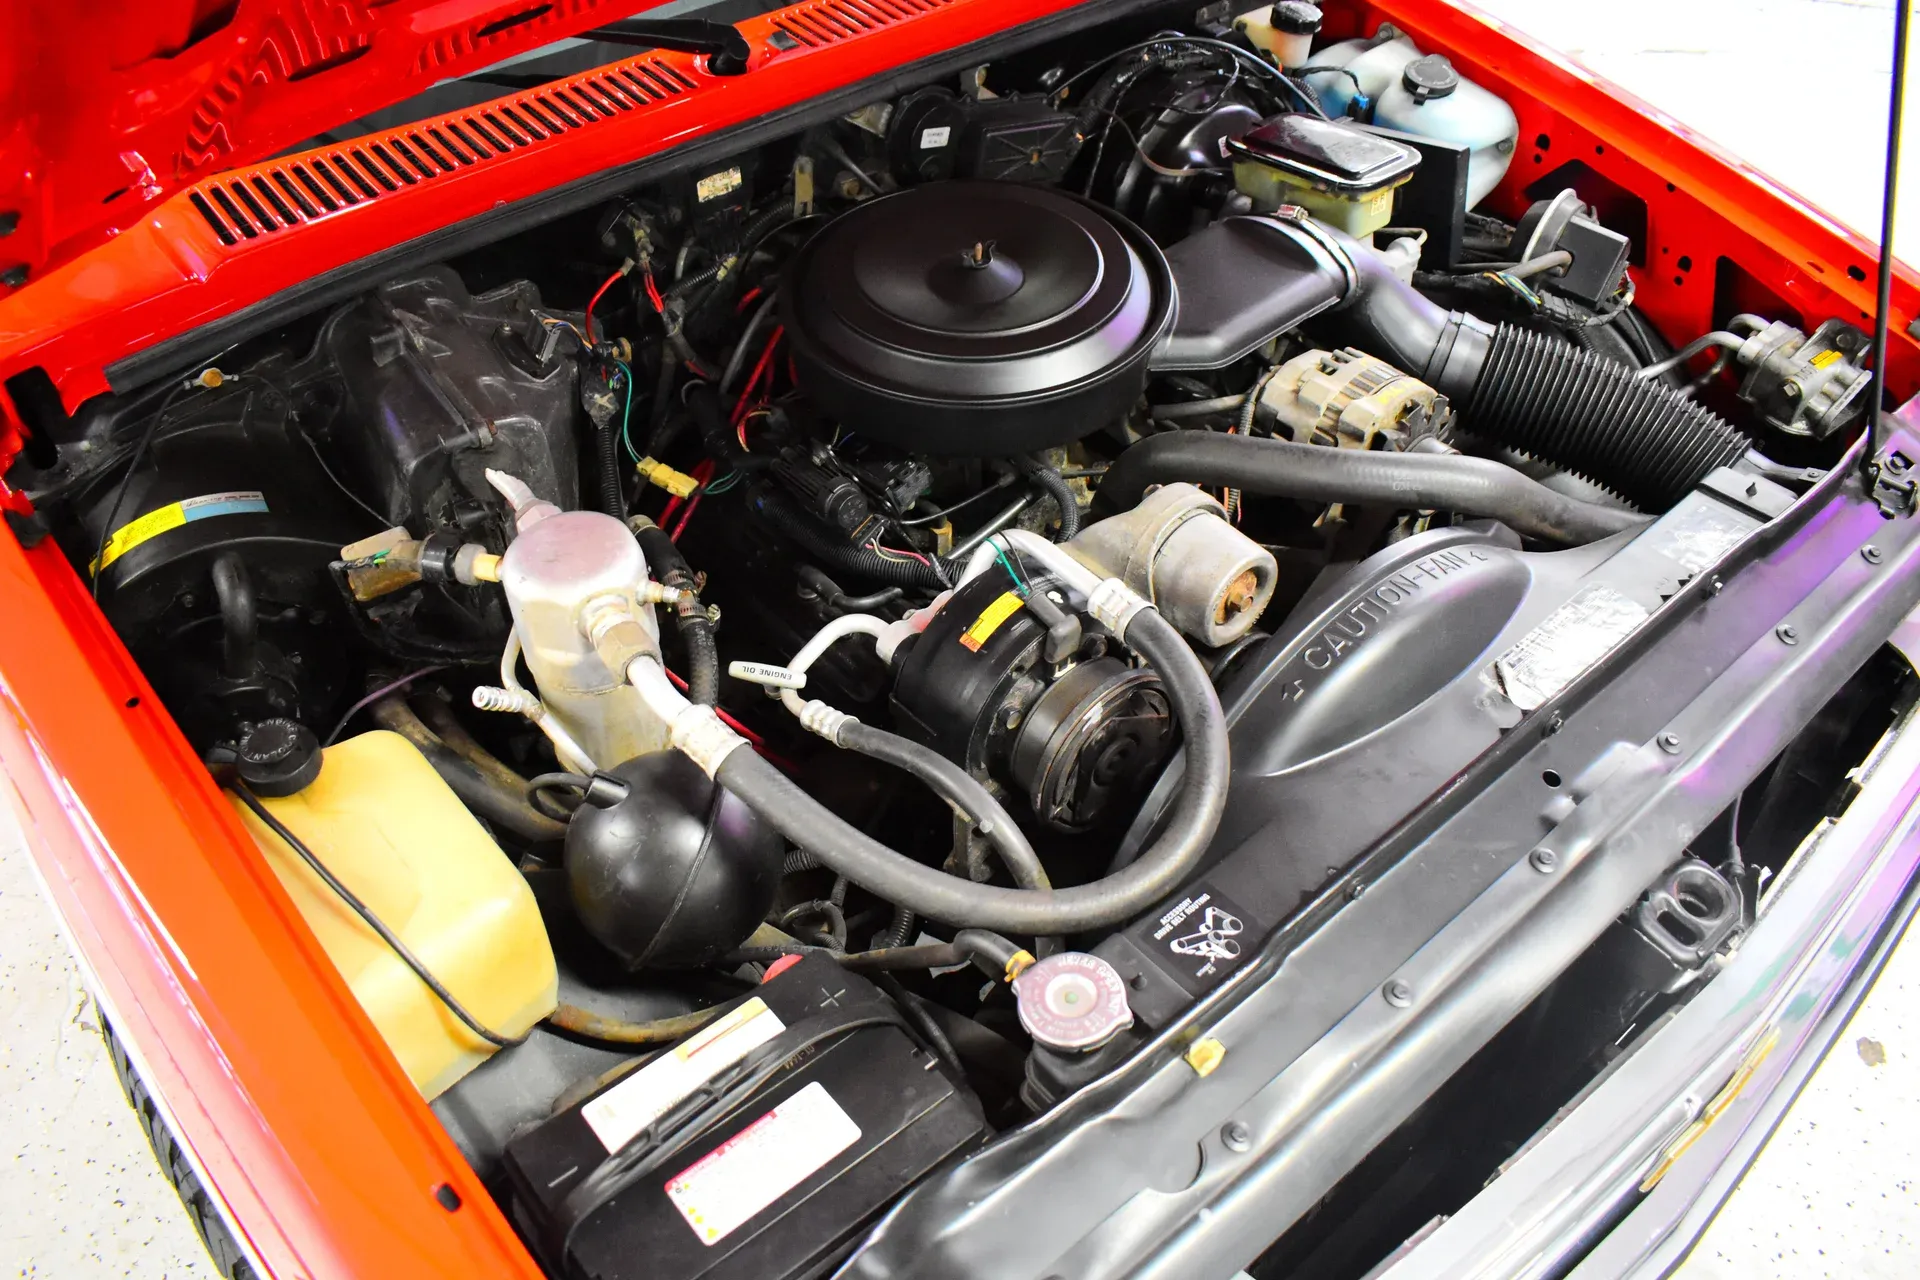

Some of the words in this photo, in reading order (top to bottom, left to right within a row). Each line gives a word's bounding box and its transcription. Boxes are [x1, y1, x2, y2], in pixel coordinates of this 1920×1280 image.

[1303, 551, 1470, 670] CAUTION-FAN
[742, 665, 756, 674] OIL
[759, 668, 793, 681] ENGINE
[1153, 923, 1174, 940] DRIVE
[1171, 910, 1187, 927] BELT
[1184, 893, 1211, 915] ROUTING
[1159, 897, 1193, 925] ACCESSORY
